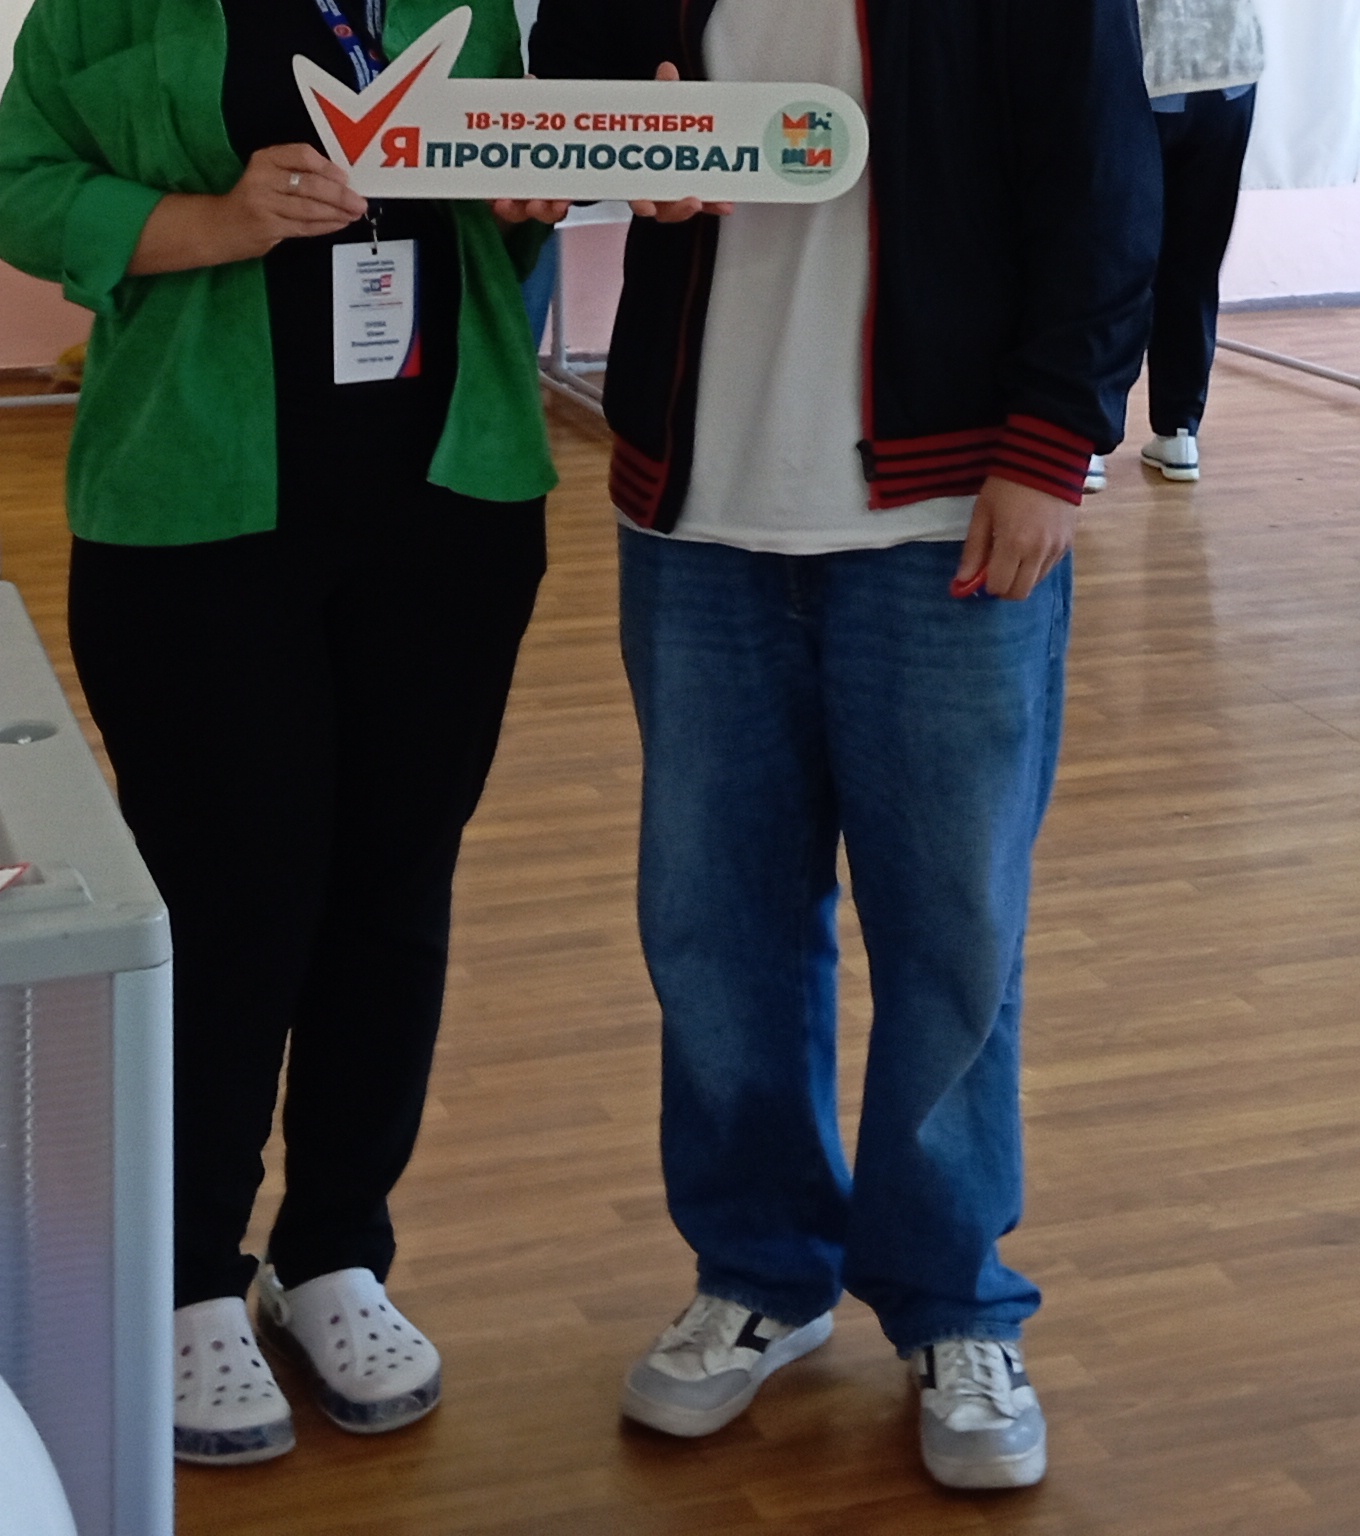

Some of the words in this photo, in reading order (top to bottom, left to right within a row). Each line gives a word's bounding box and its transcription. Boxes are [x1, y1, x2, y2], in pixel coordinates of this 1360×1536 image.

[465, 111, 566, 130] 18-19-20
[574, 113, 715, 133] СЕНТЯБРЯ
[380, 126, 420, 168] Я
[426, 141, 760, 172] ПРОГОЛОСОВАЛ
